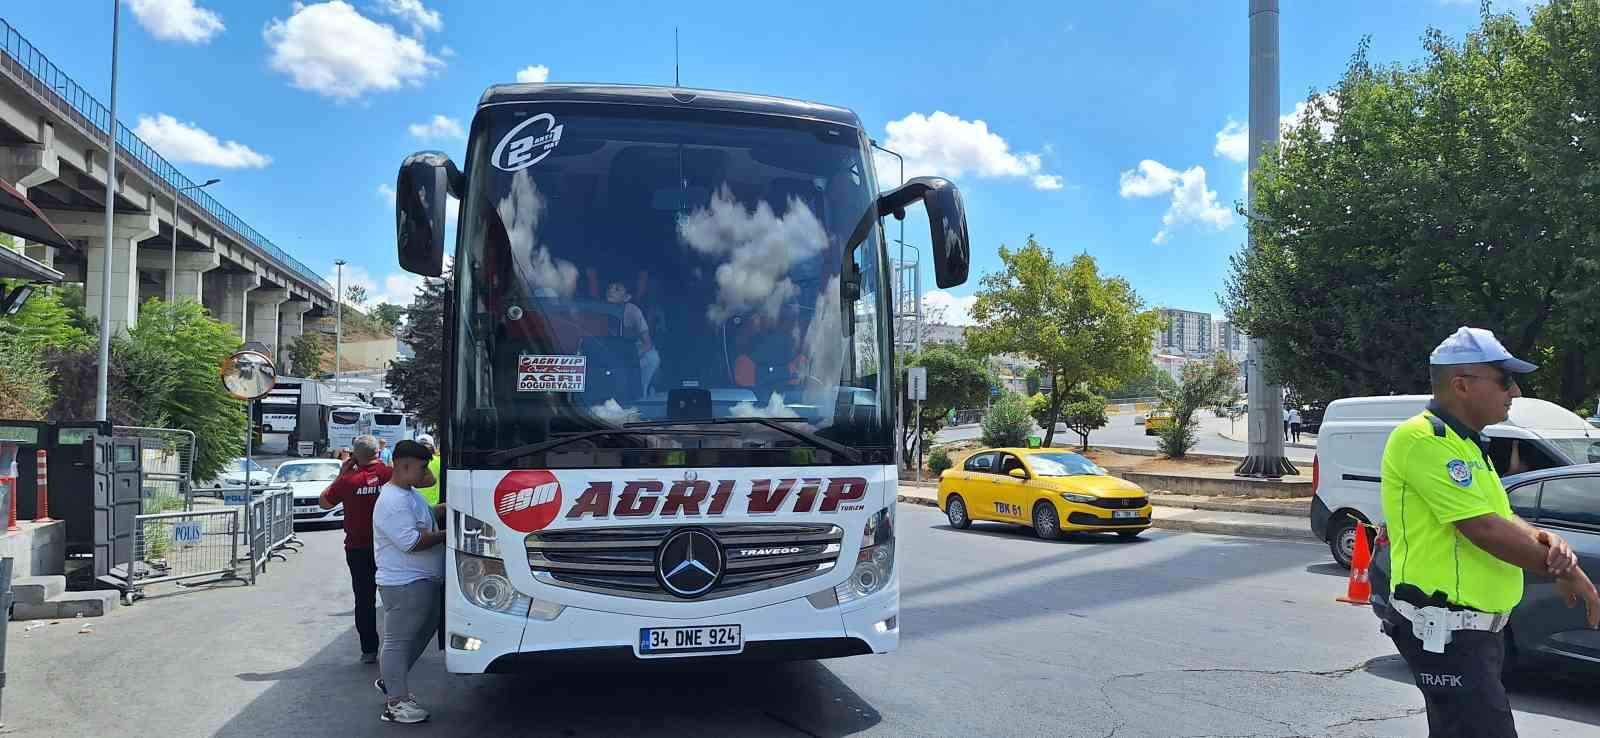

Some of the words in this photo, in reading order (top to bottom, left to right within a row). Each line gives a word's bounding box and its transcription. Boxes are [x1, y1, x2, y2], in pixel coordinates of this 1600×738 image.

[507, 136, 534, 166] 2
[550, 124, 564, 142] 1
[740, 547, 800, 556] TRAVEGO
[651, 631, 669, 647] 34
[675, 629, 702, 646] DNE
[709, 627, 735, 645] 924
